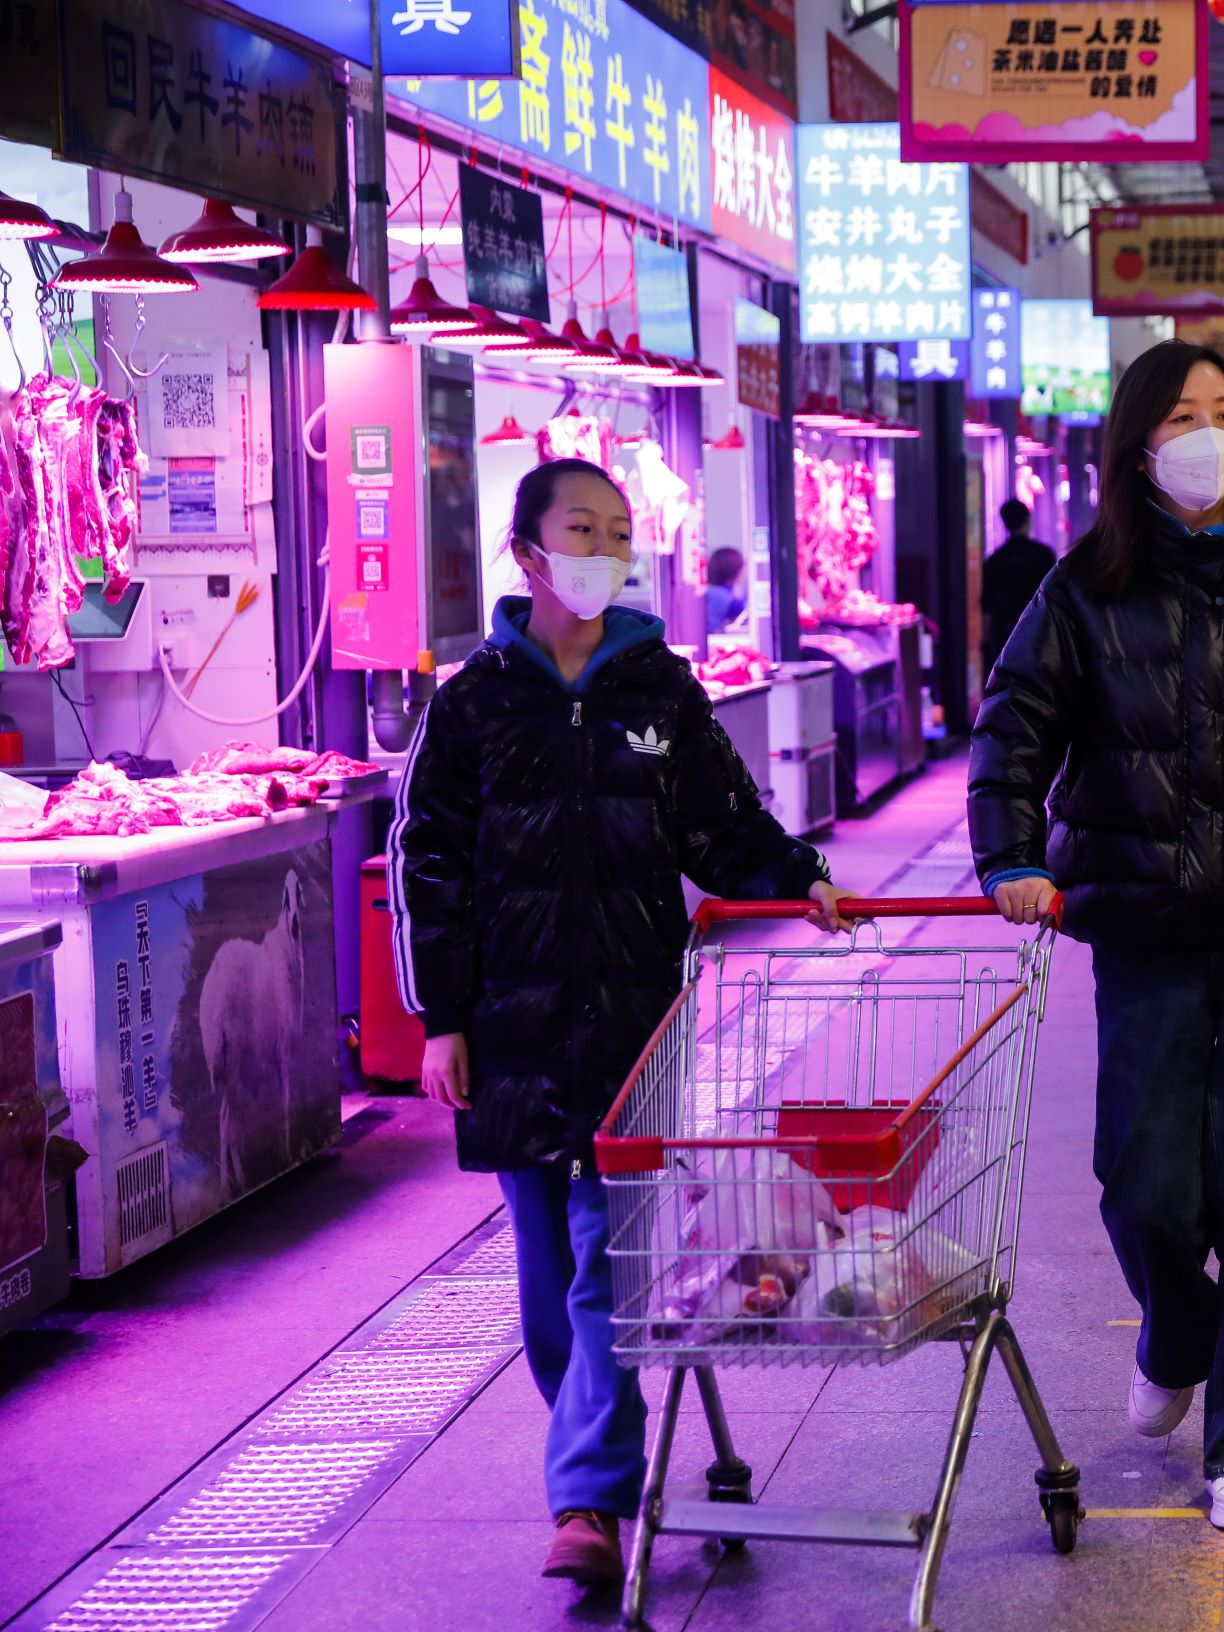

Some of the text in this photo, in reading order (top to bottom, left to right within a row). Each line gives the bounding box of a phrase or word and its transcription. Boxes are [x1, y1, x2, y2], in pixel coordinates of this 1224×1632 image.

[102, 18, 316, 177] 回民牛羊肉铺
[1089, 74, 1157, 98] 的爱情
[712, 94, 795, 242] 烧烤大全
[804, 153, 963, 197] 牛羊肉片
[804, 205, 964, 247] 安井丸子
[116, 959, 139, 1136] 乌珠穆沁羊
